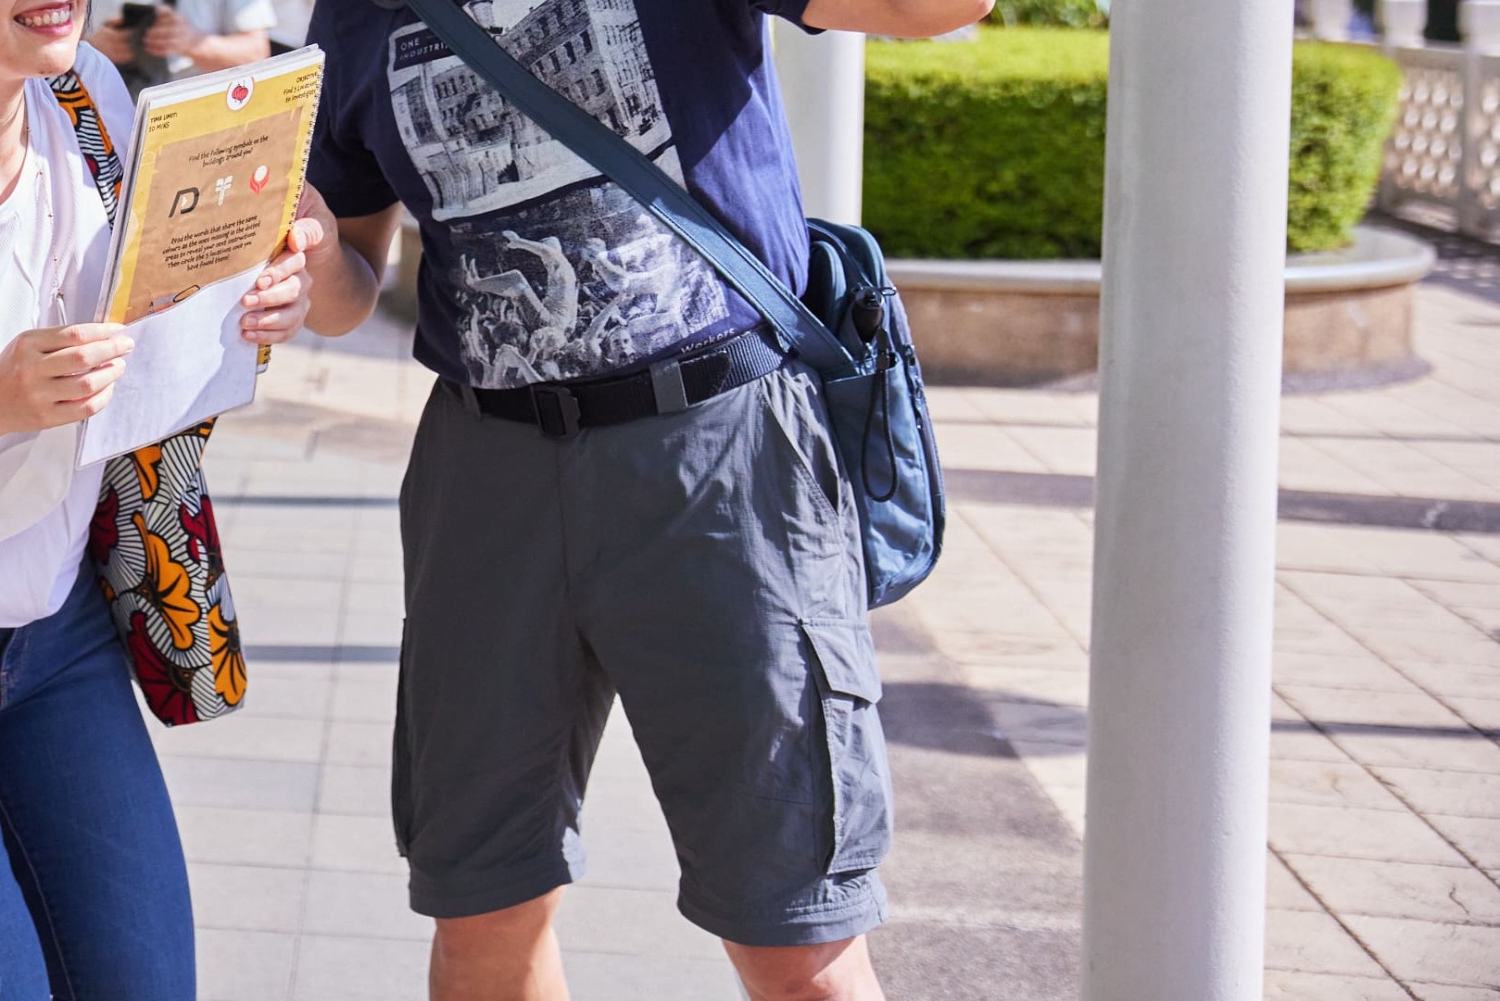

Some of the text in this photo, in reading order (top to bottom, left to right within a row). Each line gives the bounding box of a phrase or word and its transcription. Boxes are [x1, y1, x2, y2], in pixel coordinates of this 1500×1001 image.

[400, 37, 421, 51] ONE
[400, 42, 449, 60] INDUSTRI
[680, 328, 736, 354] Workers
